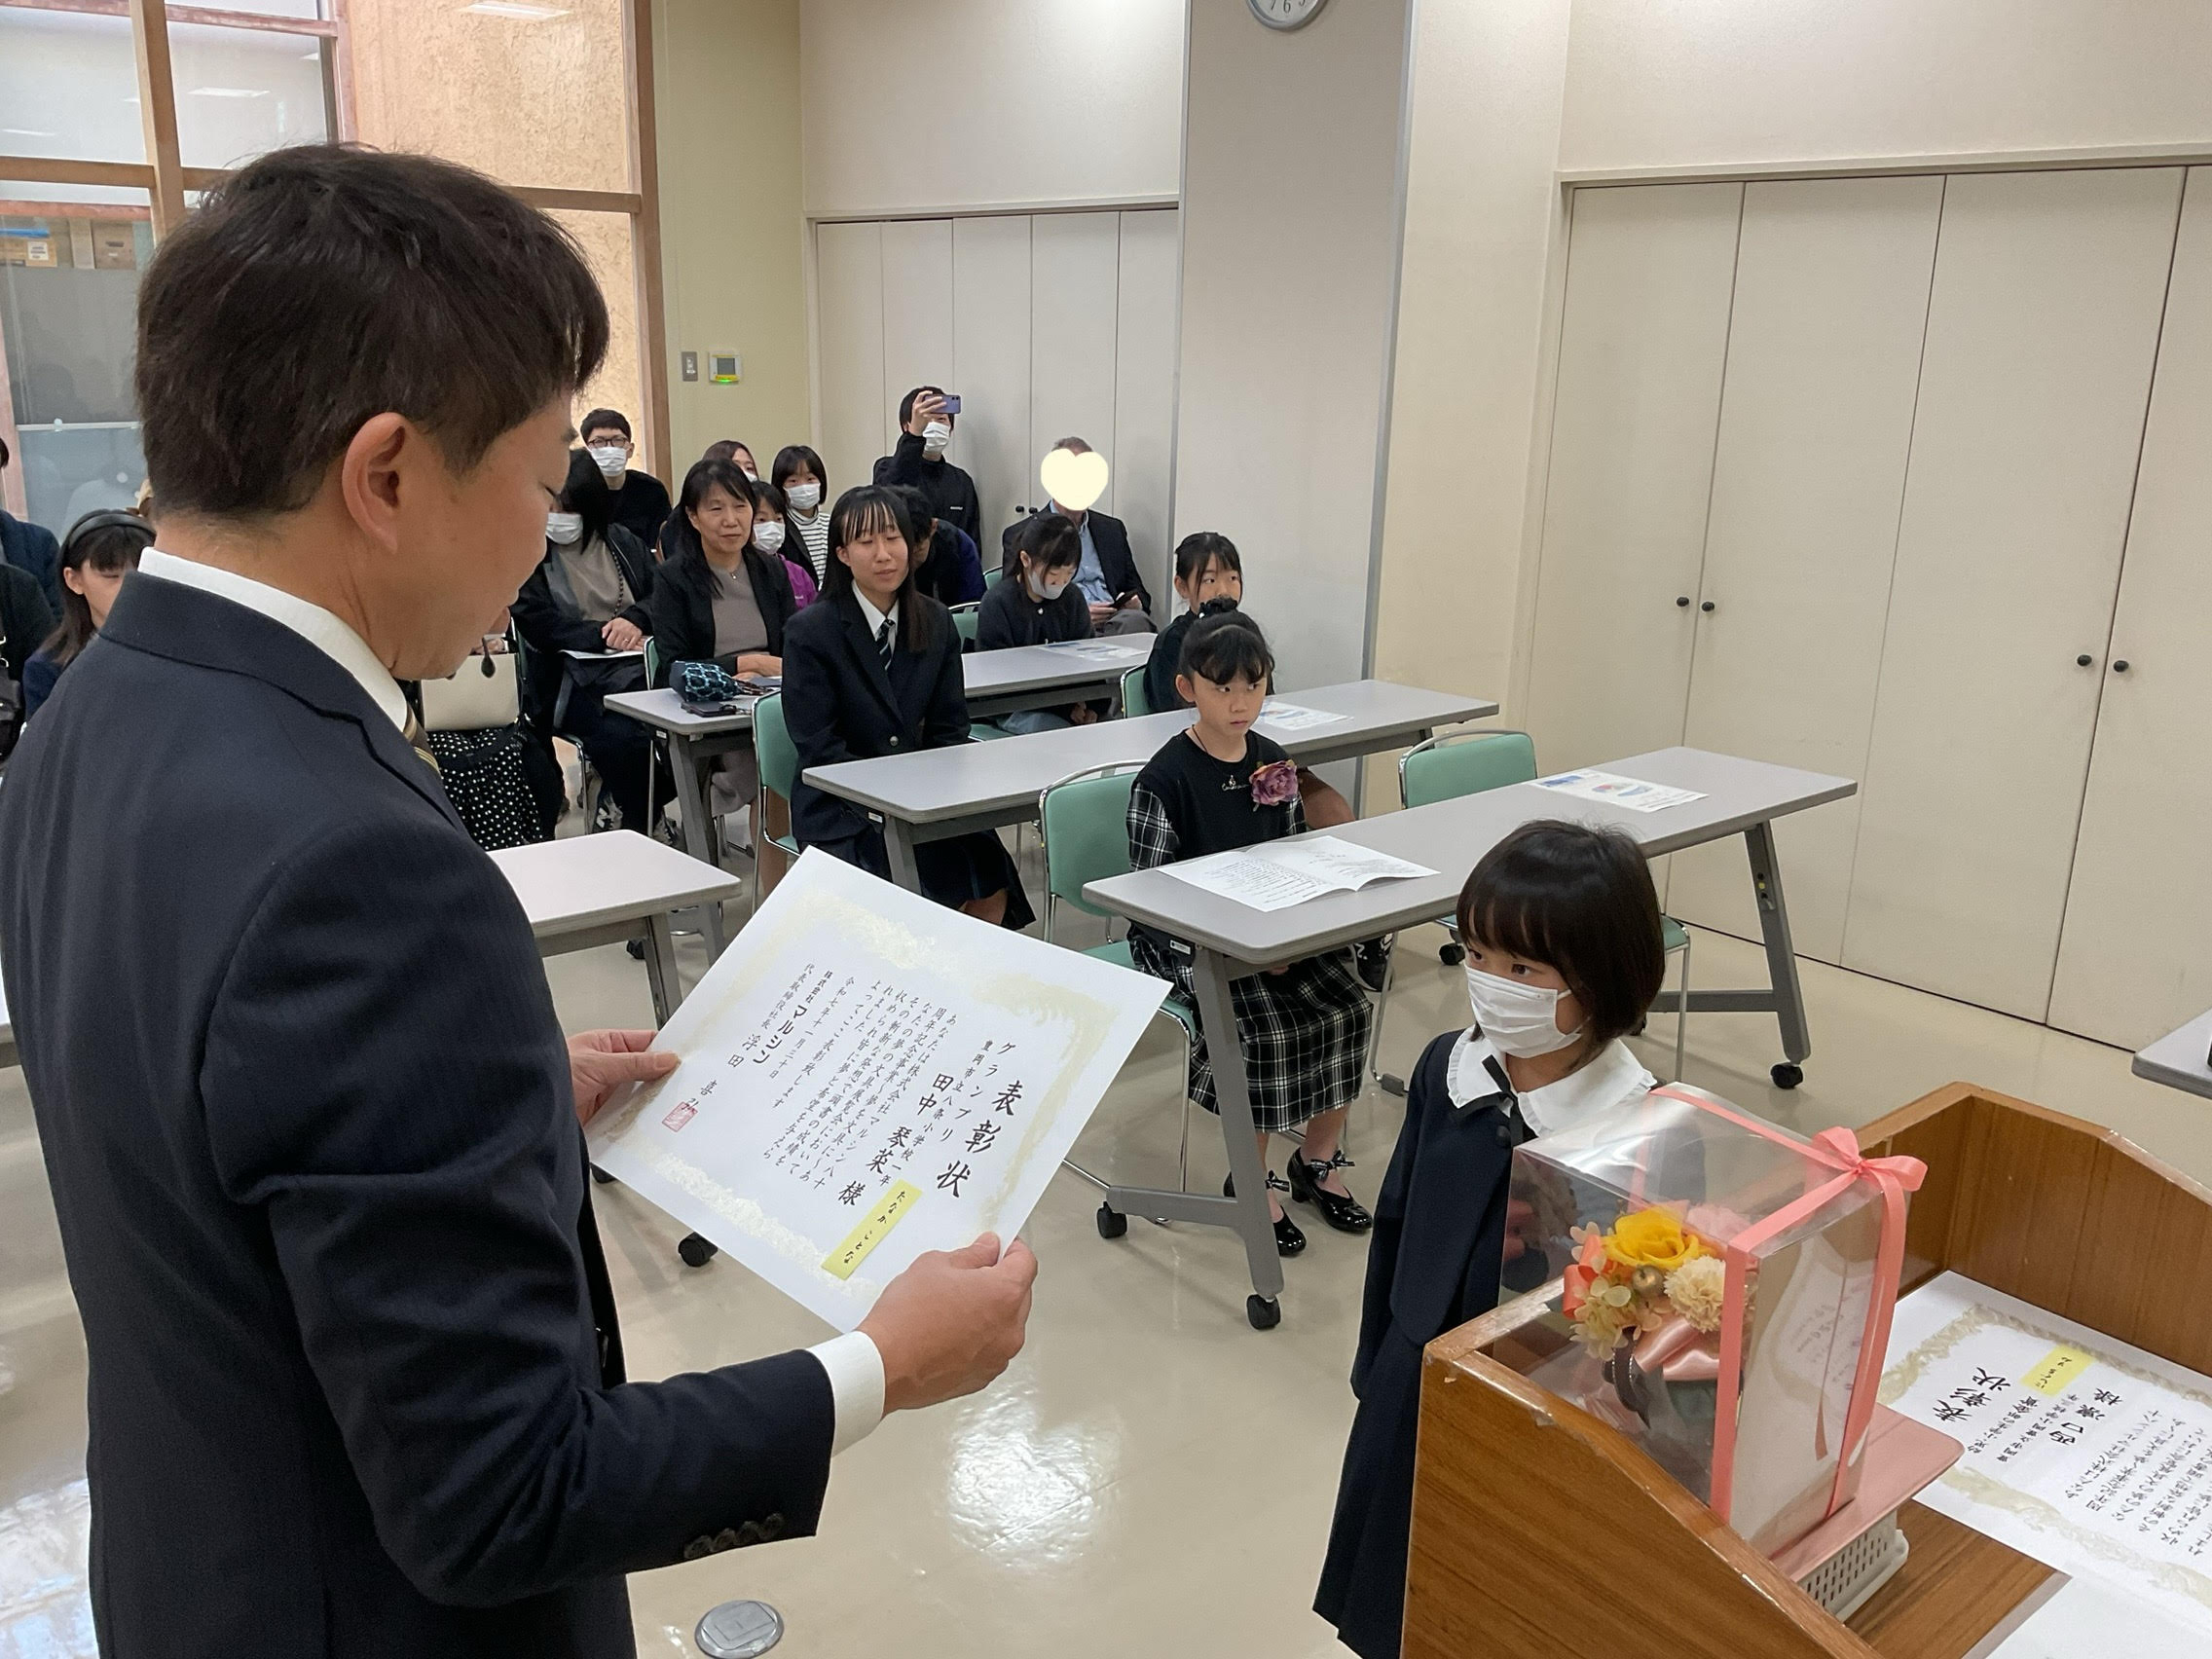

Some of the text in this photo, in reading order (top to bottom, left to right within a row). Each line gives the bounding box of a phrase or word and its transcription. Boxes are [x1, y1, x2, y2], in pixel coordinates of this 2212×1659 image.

[855, 985, 893, 1032] れました
[728, 1034, 760, 1067] 浮田
[917, 1073, 954, 1116] 田中
[937, 1043, 1022, 1198] 表彰状 グランプリ
[838, 1181, 866, 1205] 様
[877, 1191, 904, 1224] たなか
[1933, 1367, 2010, 1421] 表彰状
[2049, 1422, 2083, 1445] 西口
[2094, 1388, 2122, 1406] 様
